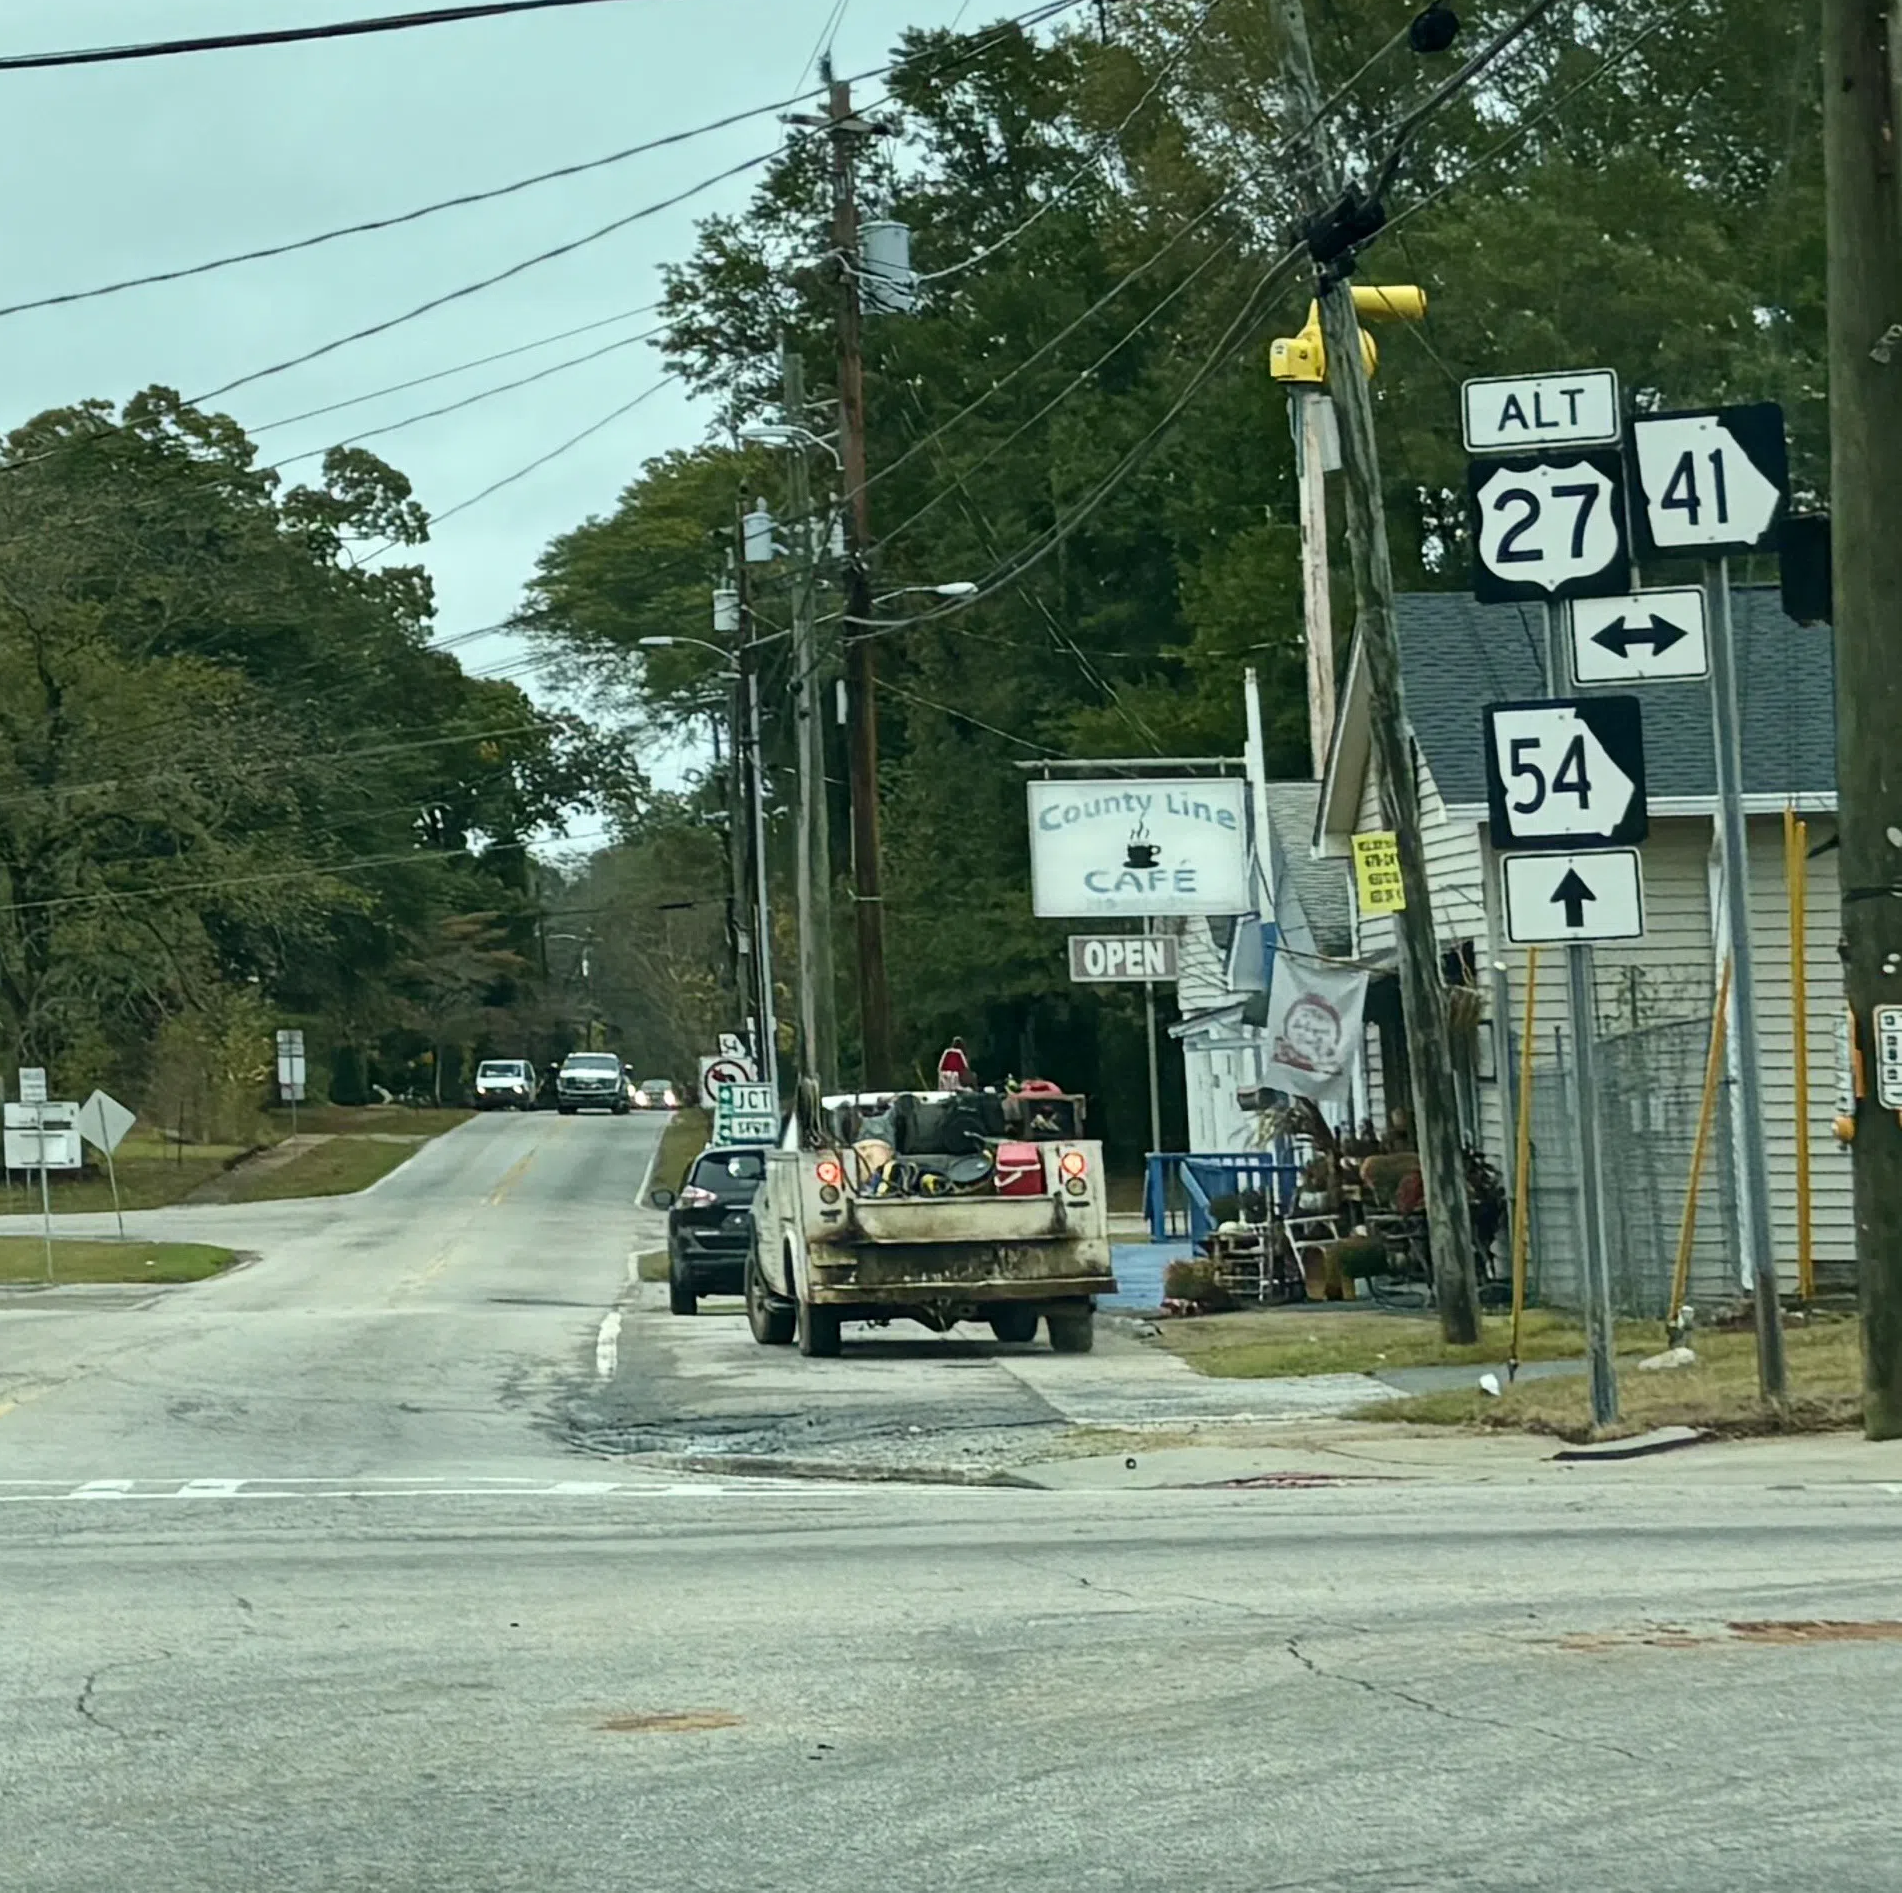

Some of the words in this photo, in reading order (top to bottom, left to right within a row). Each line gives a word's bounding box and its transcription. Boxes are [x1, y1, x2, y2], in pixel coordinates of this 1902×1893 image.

[1498, 389, 1585, 433] ALT
[1661, 447, 1730, 526] 41
[1493, 482, 1600, 564] 27
[1509, 734, 1592, 815] 54
[1037, 791, 1154, 833] County
[1165, 792, 1237, 831] Line
[1083, 858, 1197, 895] CAFÉ
[1083, 940, 1166, 976] OPEN
[735, 1090, 768, 1109] JCT
